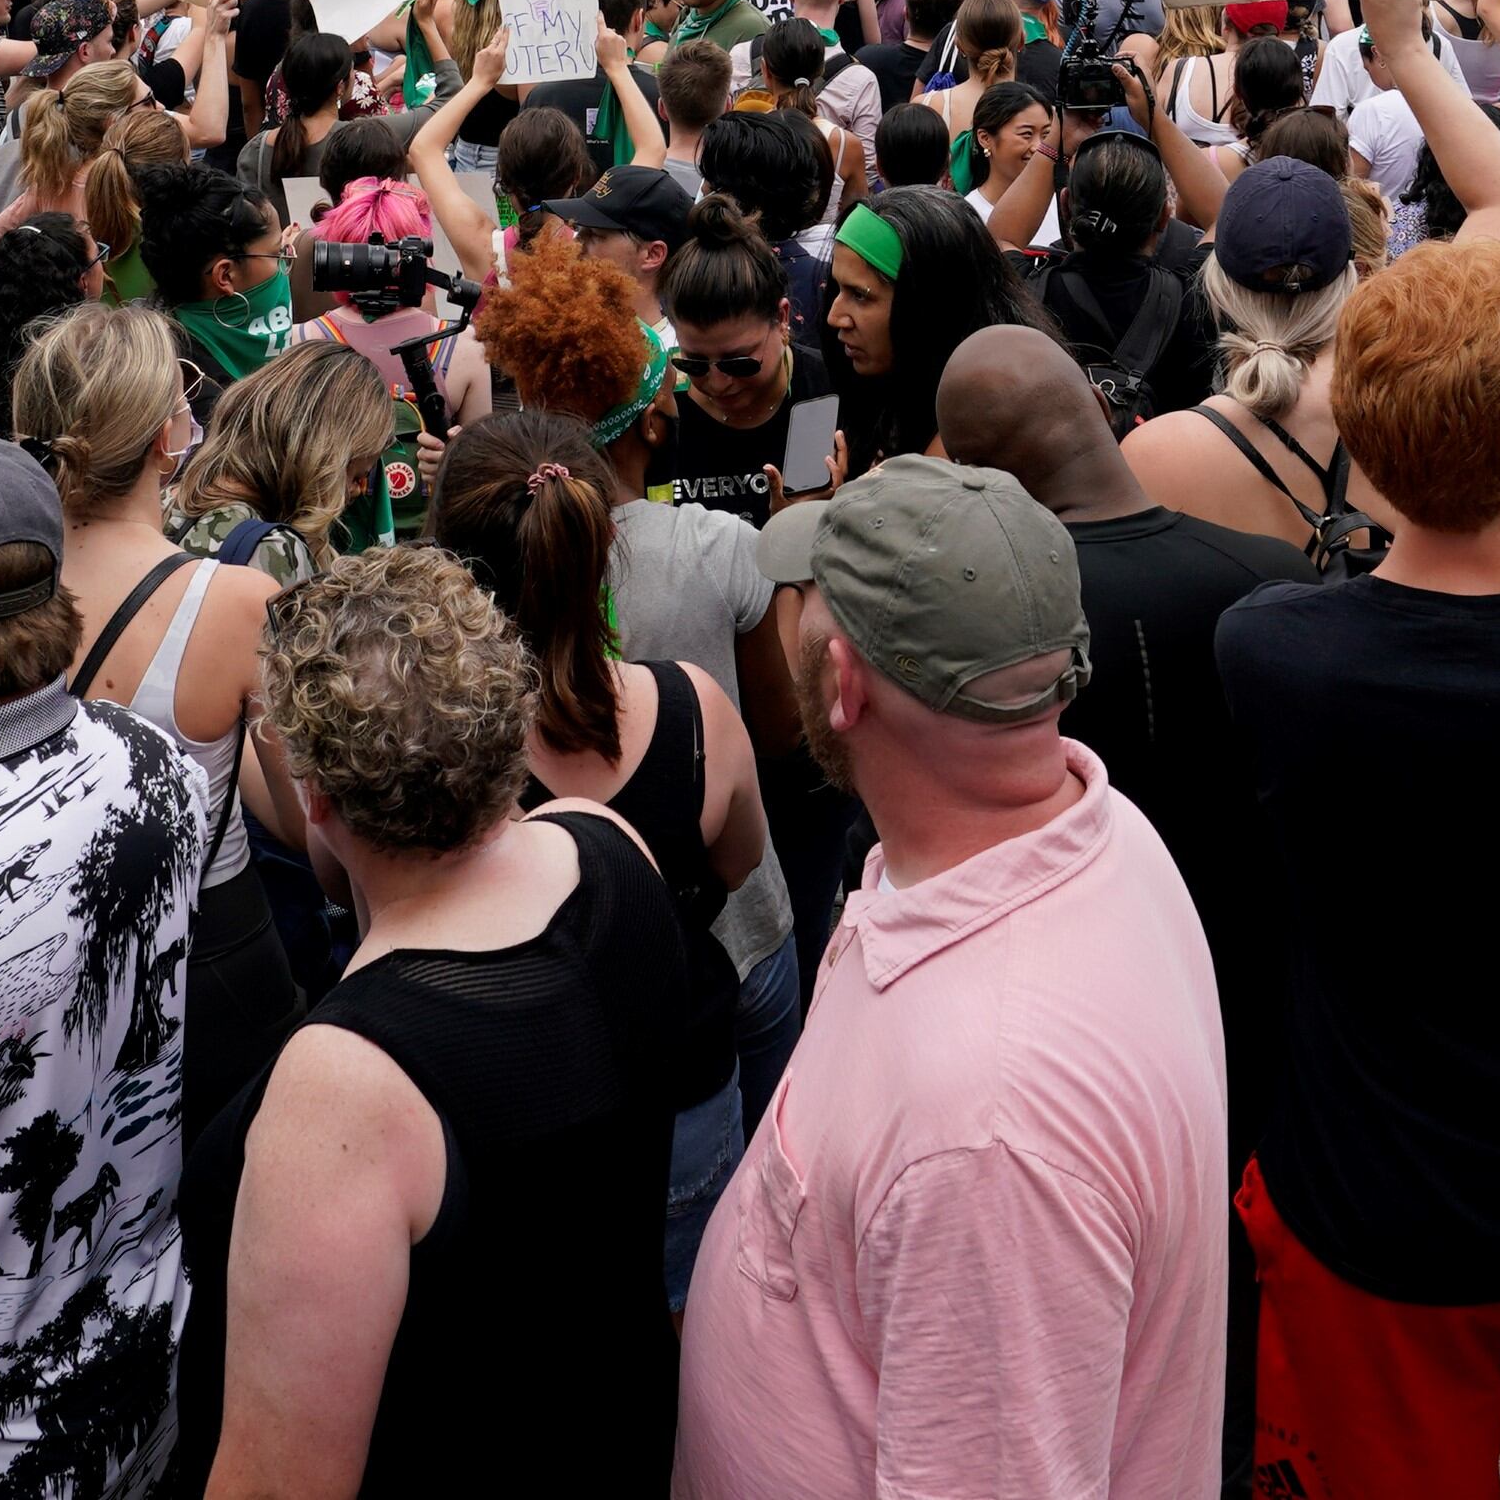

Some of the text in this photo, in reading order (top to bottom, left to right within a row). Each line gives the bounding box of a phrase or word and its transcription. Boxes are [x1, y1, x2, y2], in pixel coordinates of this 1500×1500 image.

[541, 10, 582, 52] MY
[505, 40, 595, 77] UTERU
[672, 473, 770, 499] EVERYO
